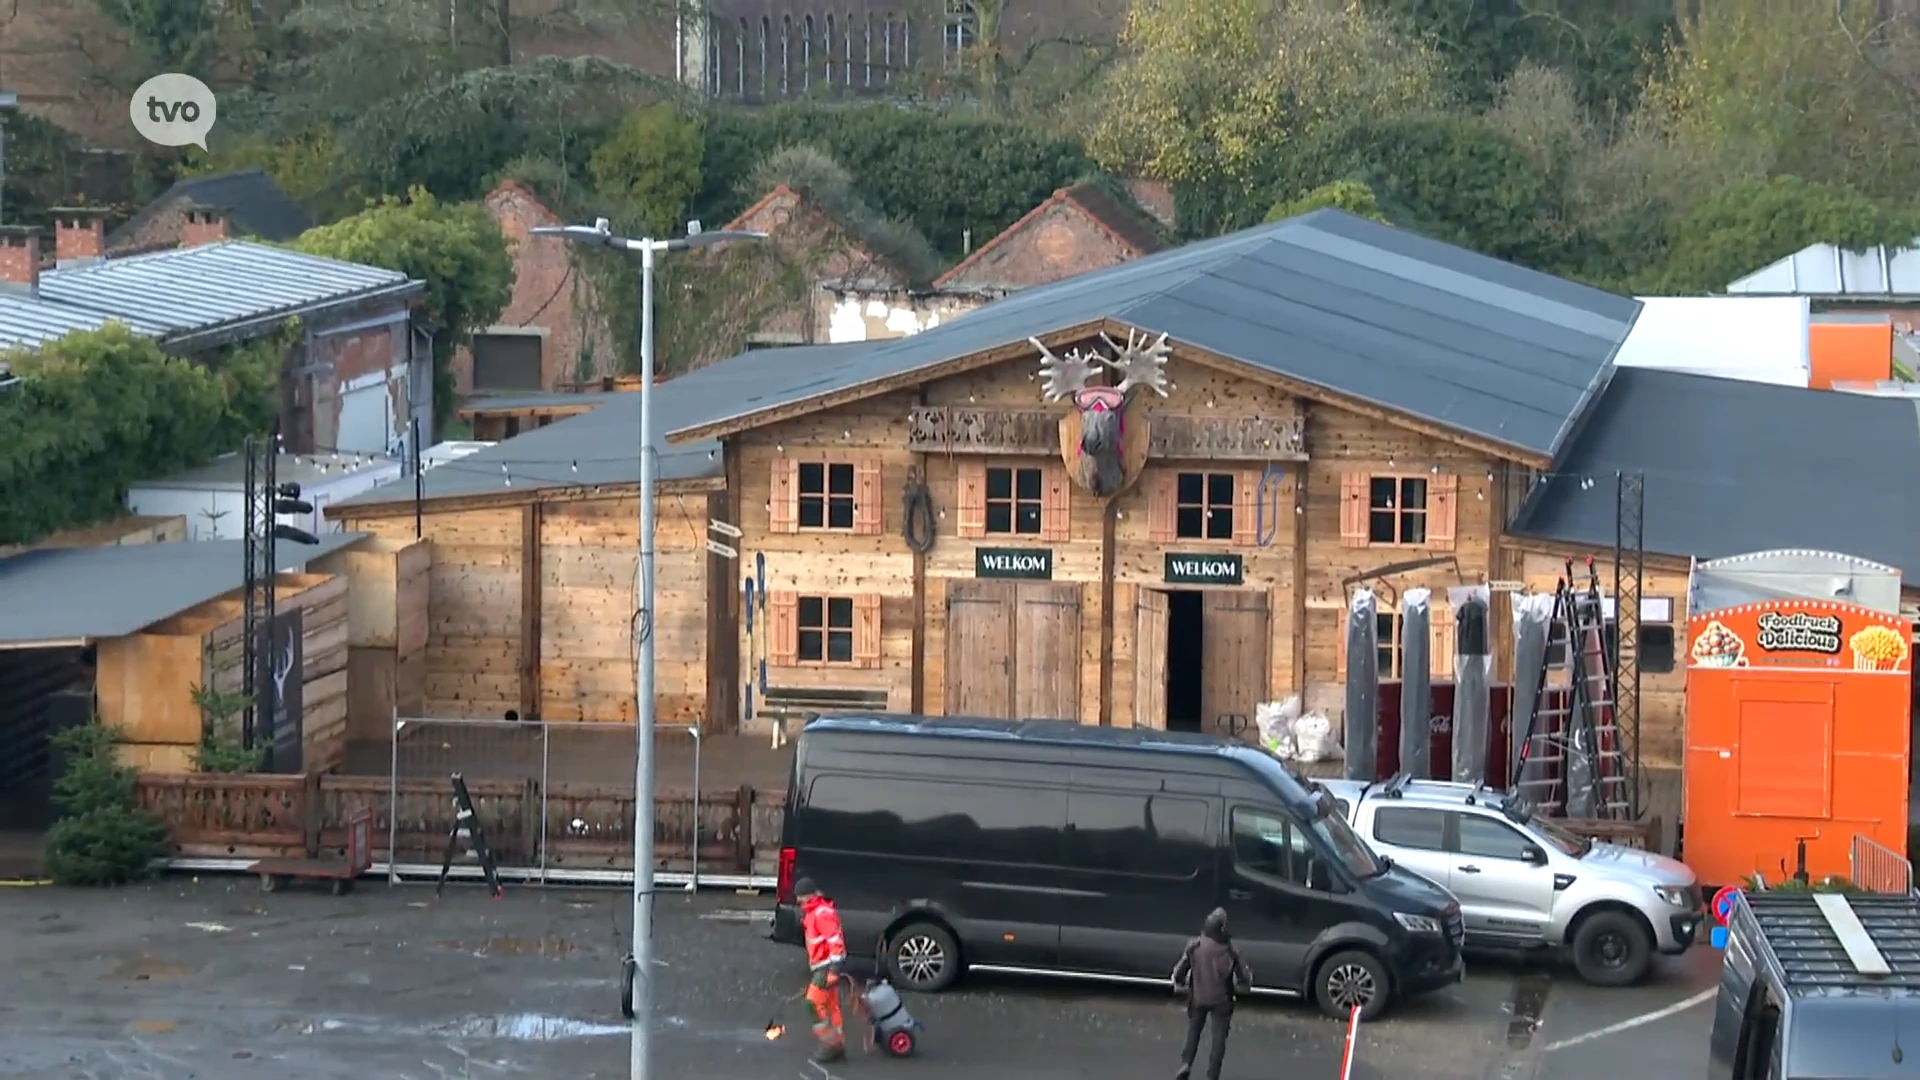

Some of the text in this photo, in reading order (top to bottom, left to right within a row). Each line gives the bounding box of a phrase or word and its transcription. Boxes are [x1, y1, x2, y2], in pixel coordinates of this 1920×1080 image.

[982, 555, 1046, 572] WELKOM
[1172, 561, 1235, 577] WELKOM
[1759, 613, 1838, 630] Foodtruck
[1759, 630, 1838, 649] Delicious
